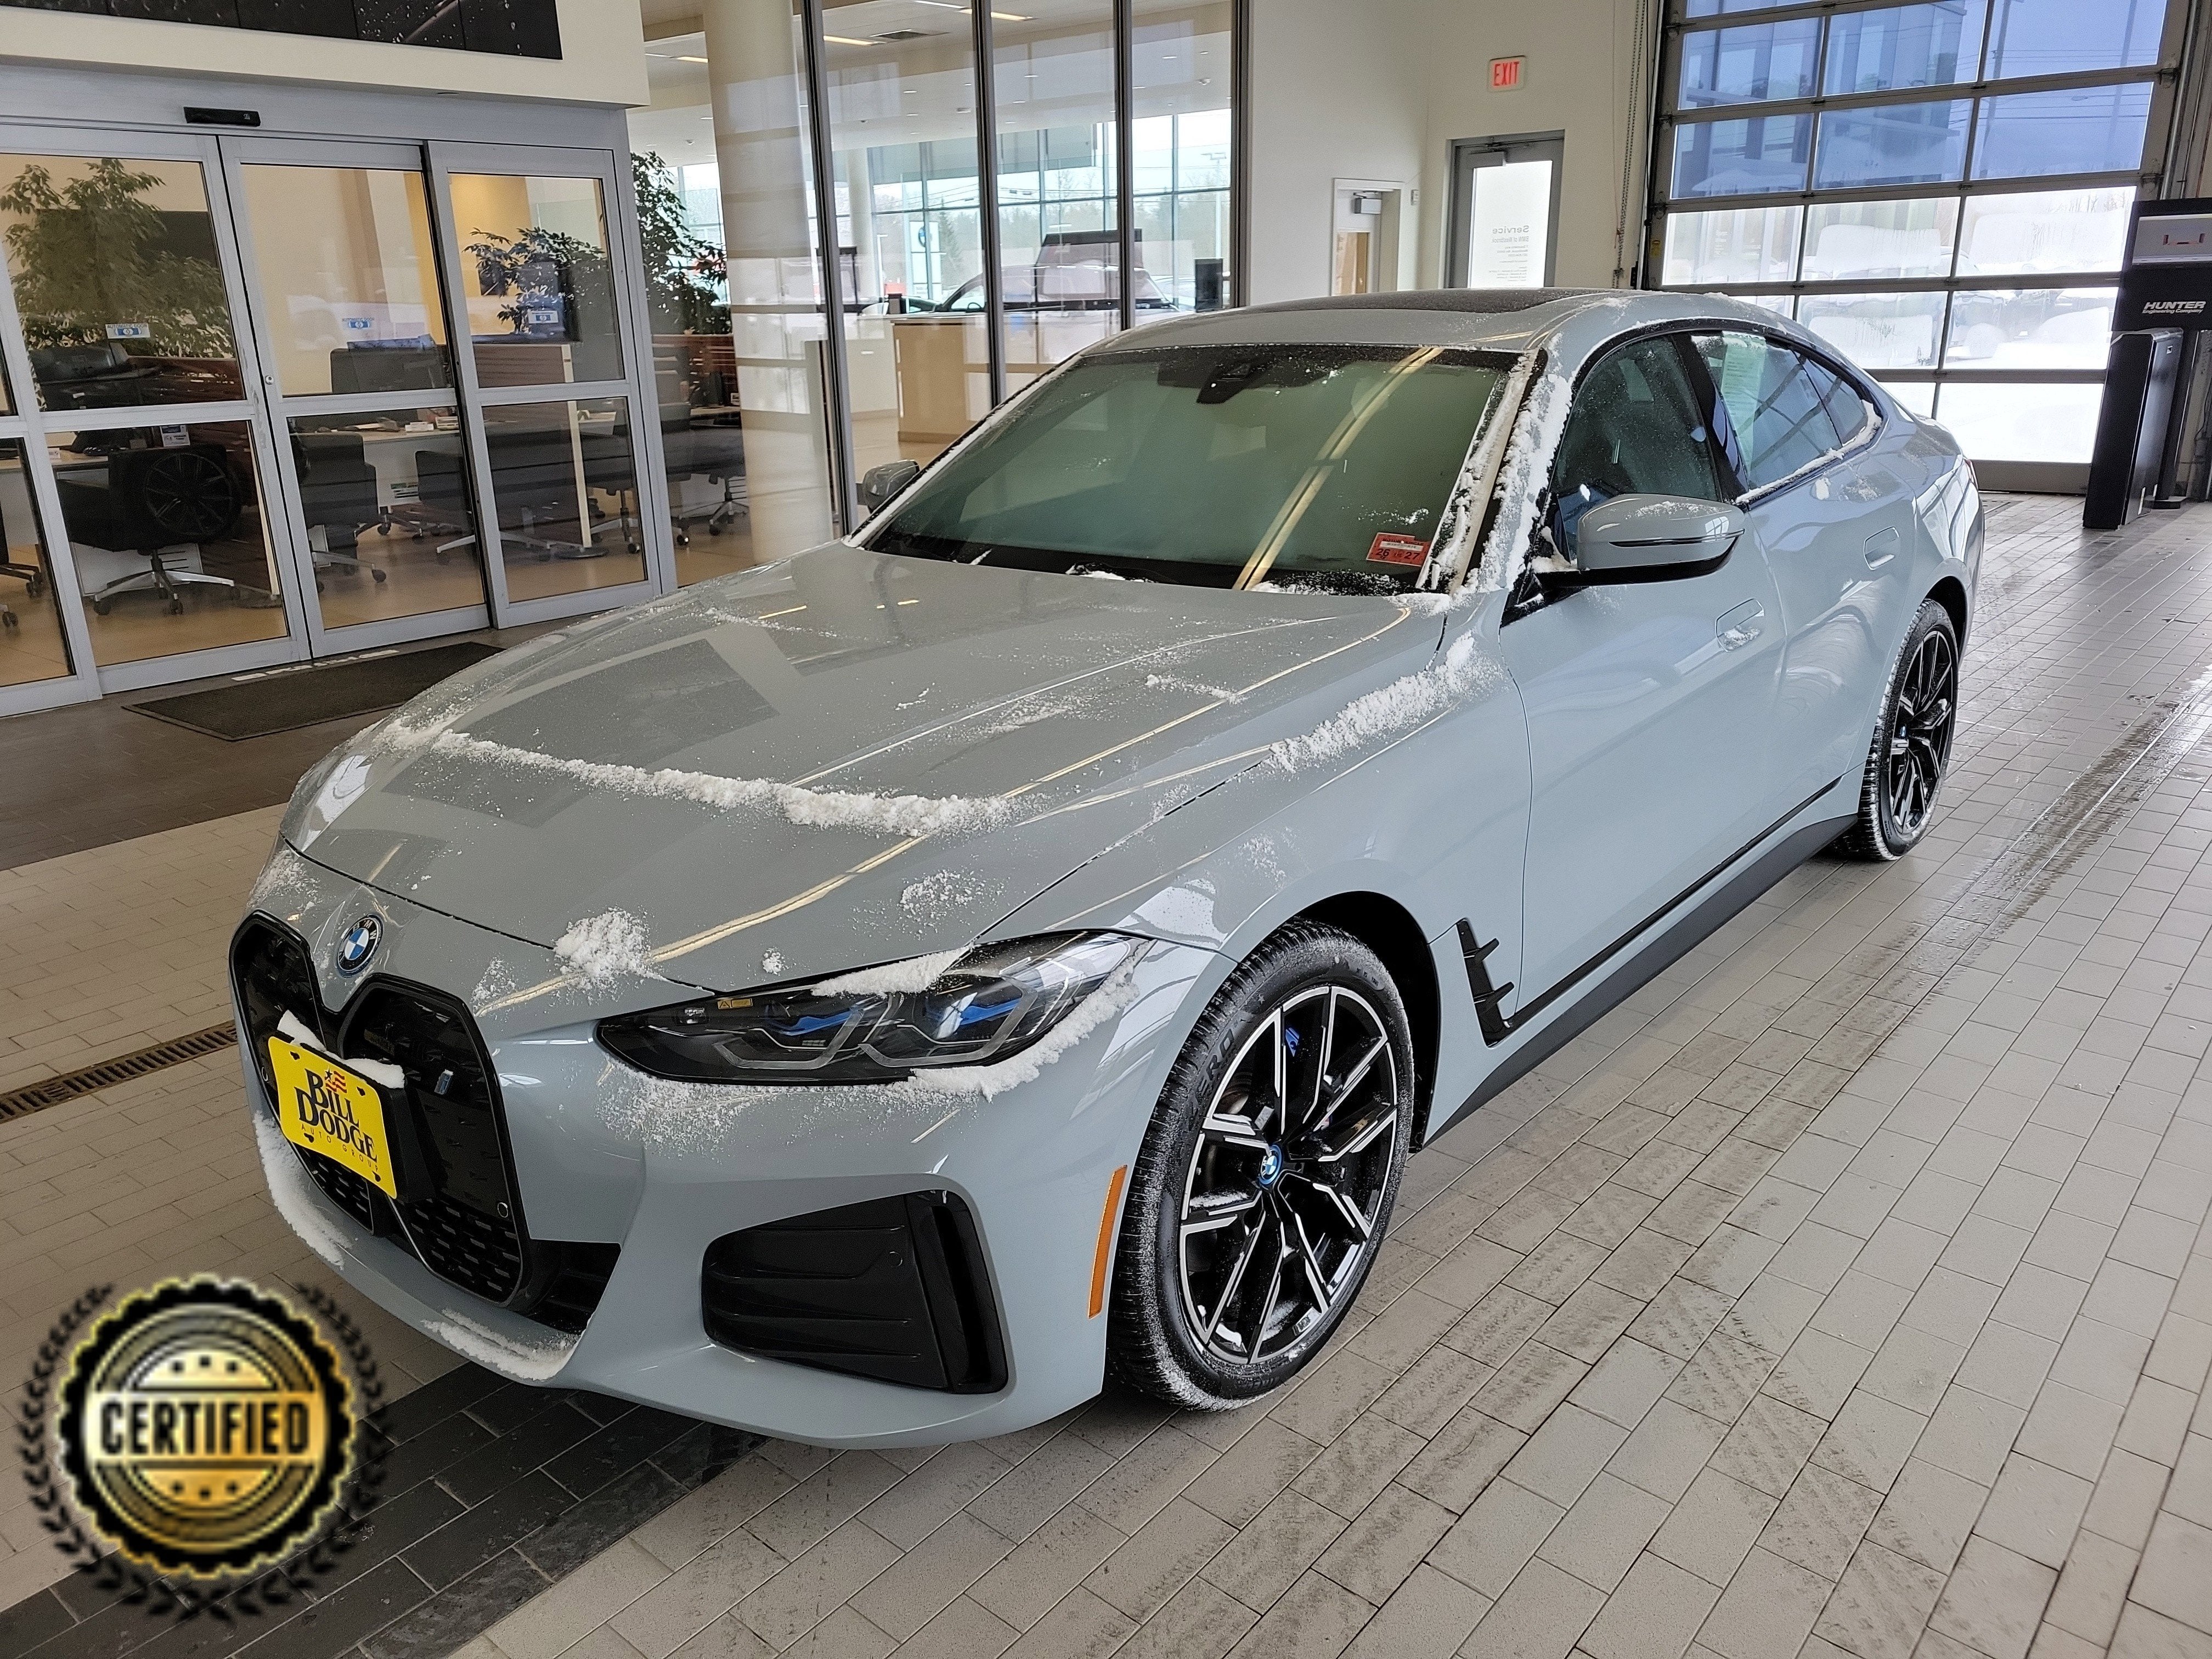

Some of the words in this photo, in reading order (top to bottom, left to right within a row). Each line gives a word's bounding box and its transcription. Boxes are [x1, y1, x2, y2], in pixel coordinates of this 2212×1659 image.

[1493, 61, 1520, 86] EXIT
[1404, 551, 1420, 560] 27
[353, 919, 377, 940] BMW
[304, 1068, 359, 1128] BILL
[294, 1086, 377, 1163] DODGE
[301, 1124, 331, 1143] AUTO
[342, 1144, 379, 1172] GROUP
